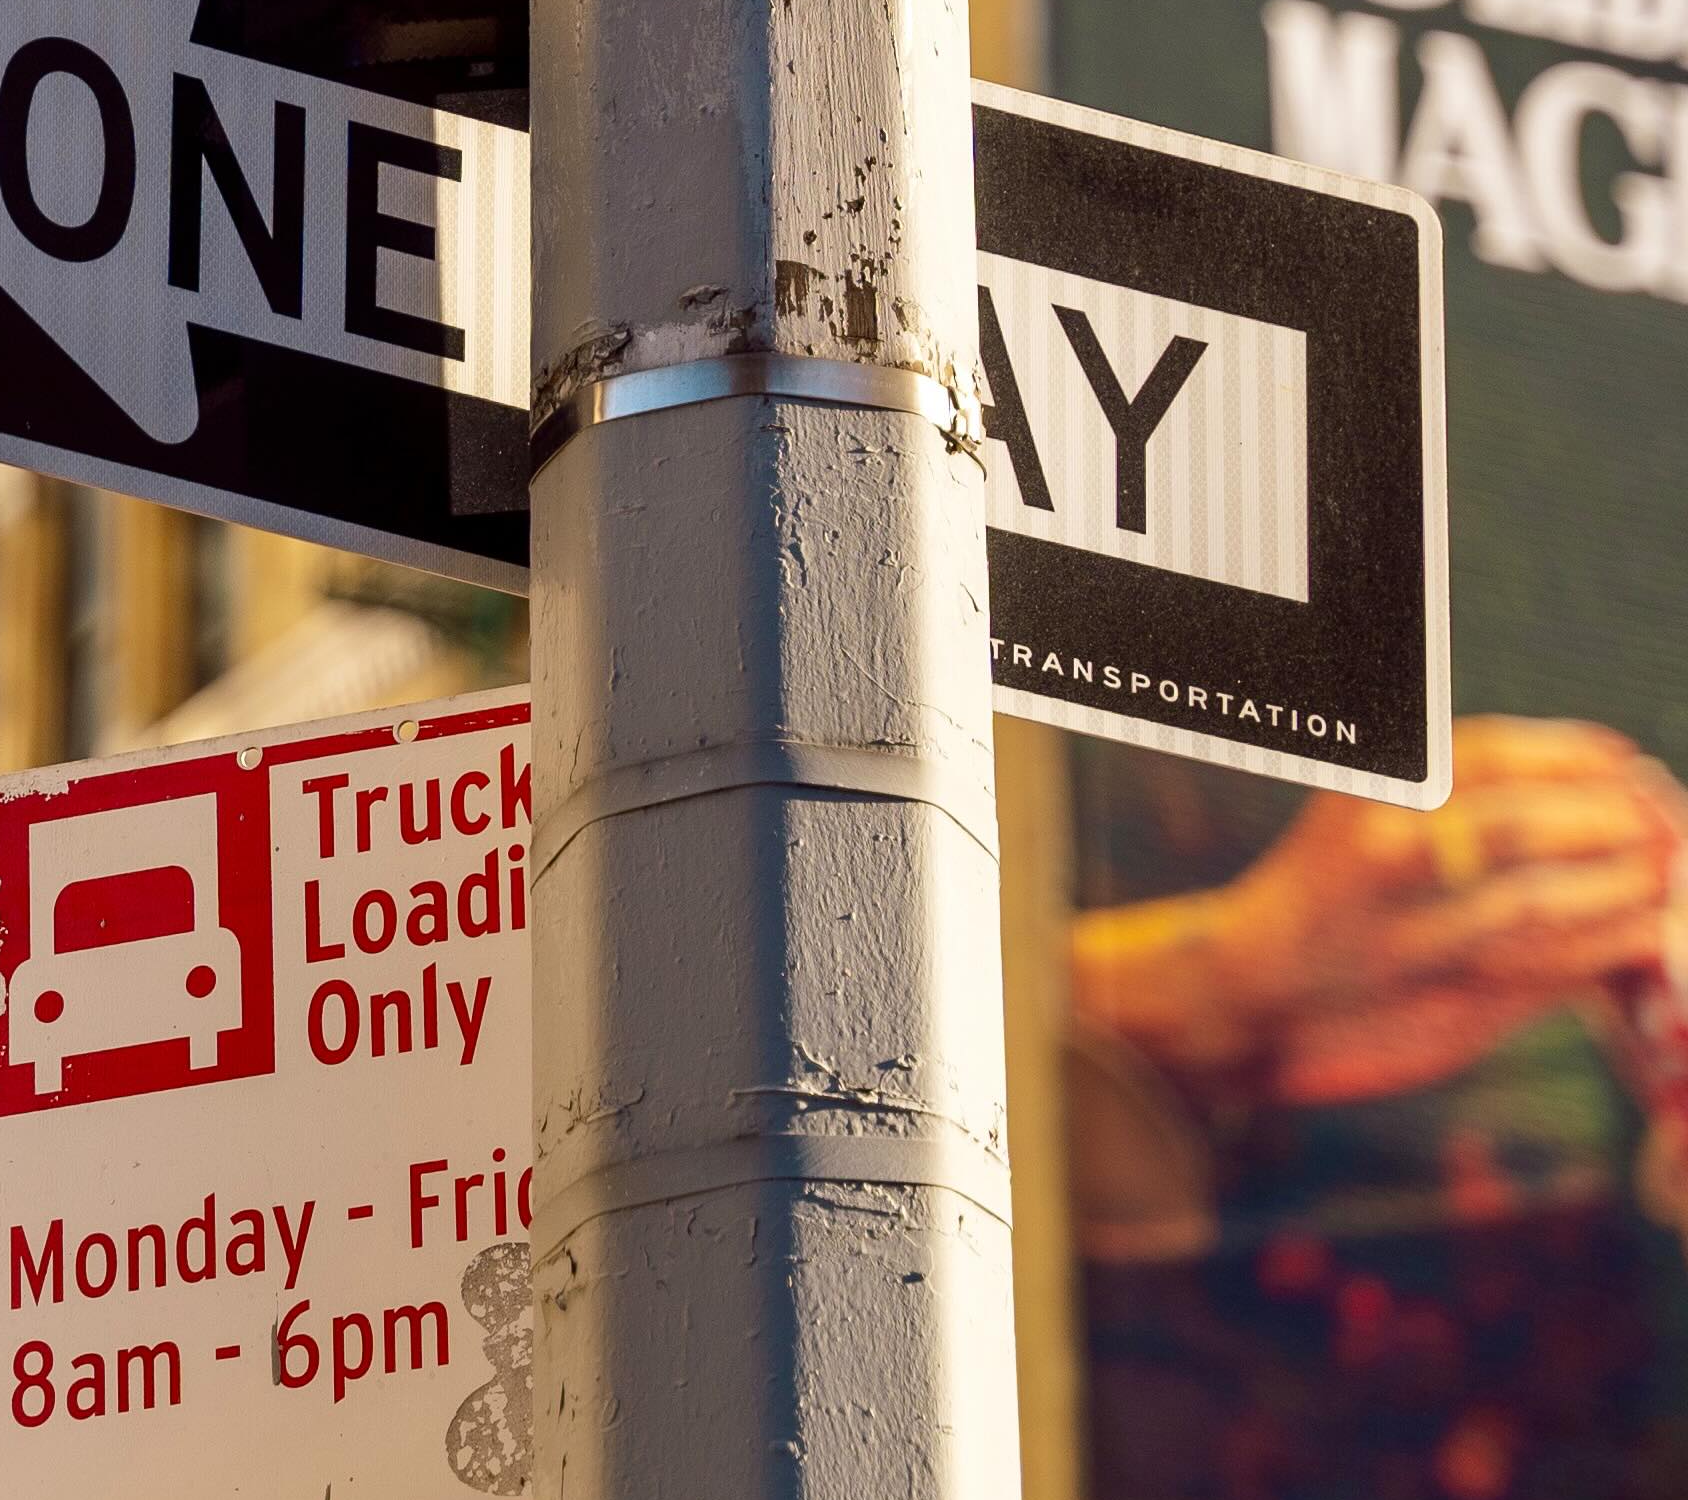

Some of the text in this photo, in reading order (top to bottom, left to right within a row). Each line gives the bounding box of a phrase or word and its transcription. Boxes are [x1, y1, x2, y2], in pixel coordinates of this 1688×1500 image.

[990, 637, 1357, 745] TRANSPORTATION
[302, 743, 532, 858] Truck
[305, 843, 527, 963] Loadi
[308, 962, 492, 1066] Only
[11, 1148, 533, 1309] Monday - Fri
[11, 1297, 450, 1428] 8am - 6pm
